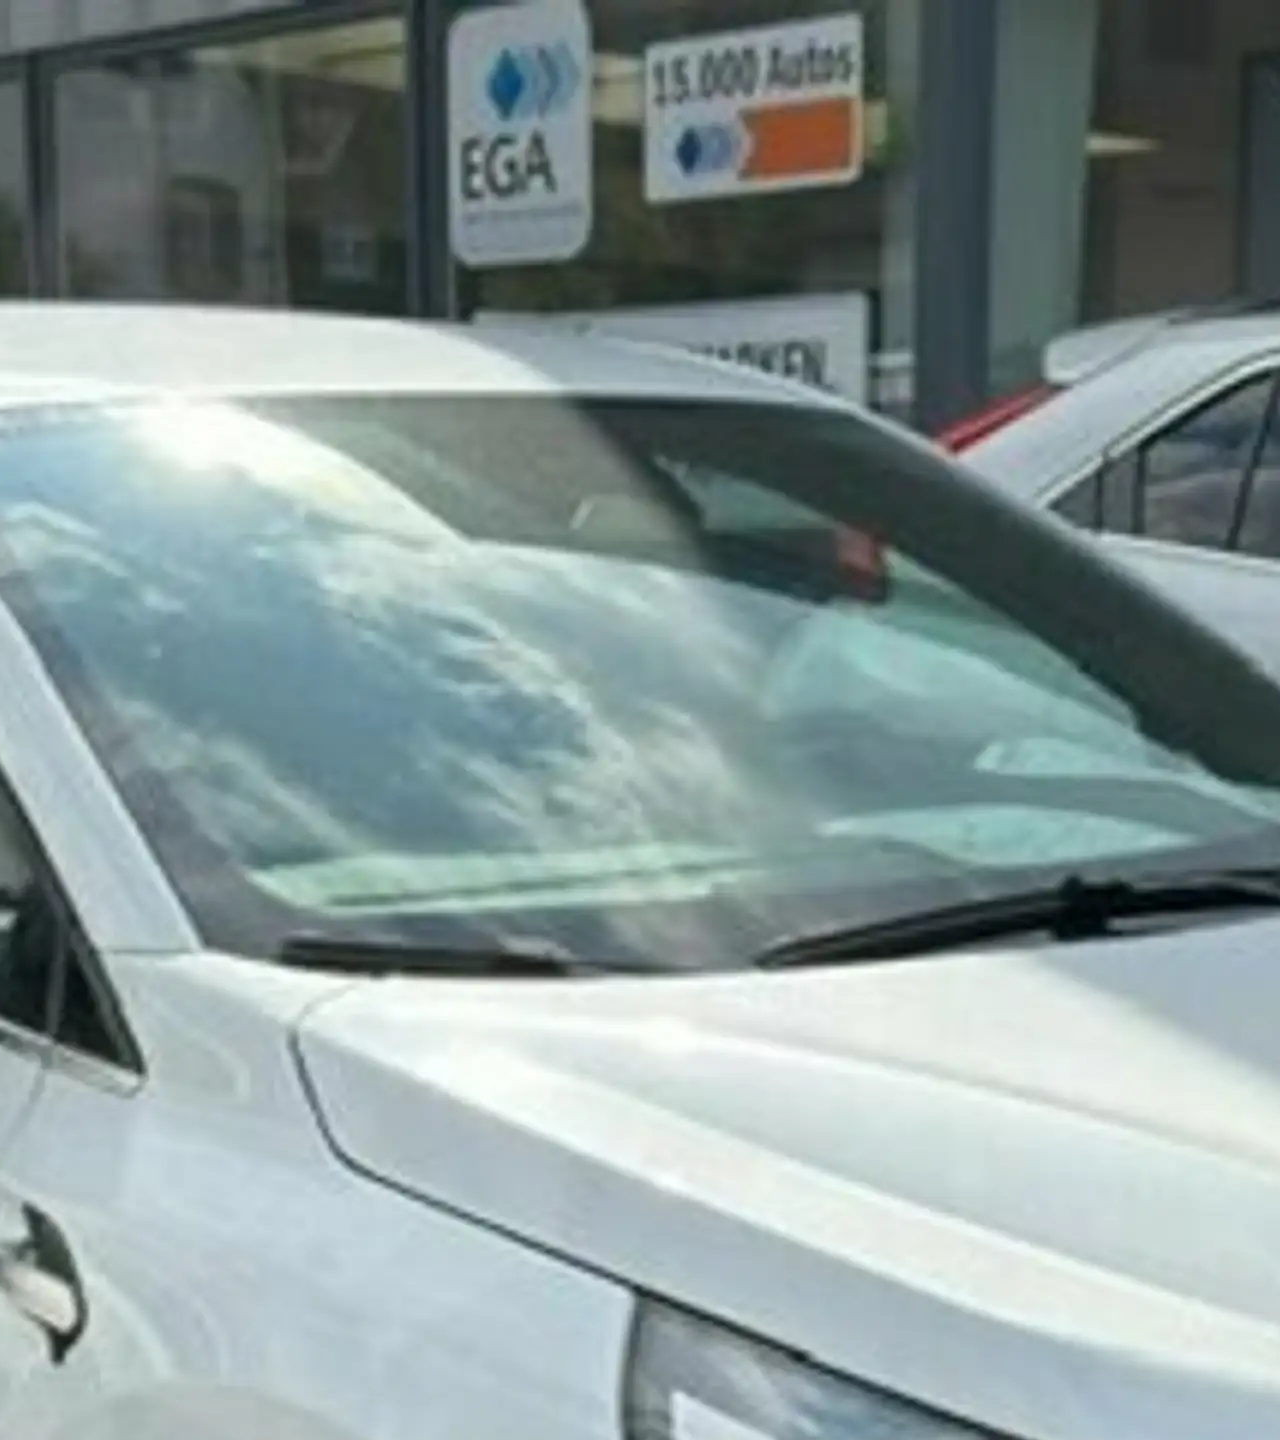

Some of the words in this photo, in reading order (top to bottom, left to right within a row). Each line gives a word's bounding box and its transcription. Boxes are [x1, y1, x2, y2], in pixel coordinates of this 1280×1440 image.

[652, 46, 761, 107] 15.000
[767, 37, 857, 90] Autos
[460, 127, 558, 200] EGA
